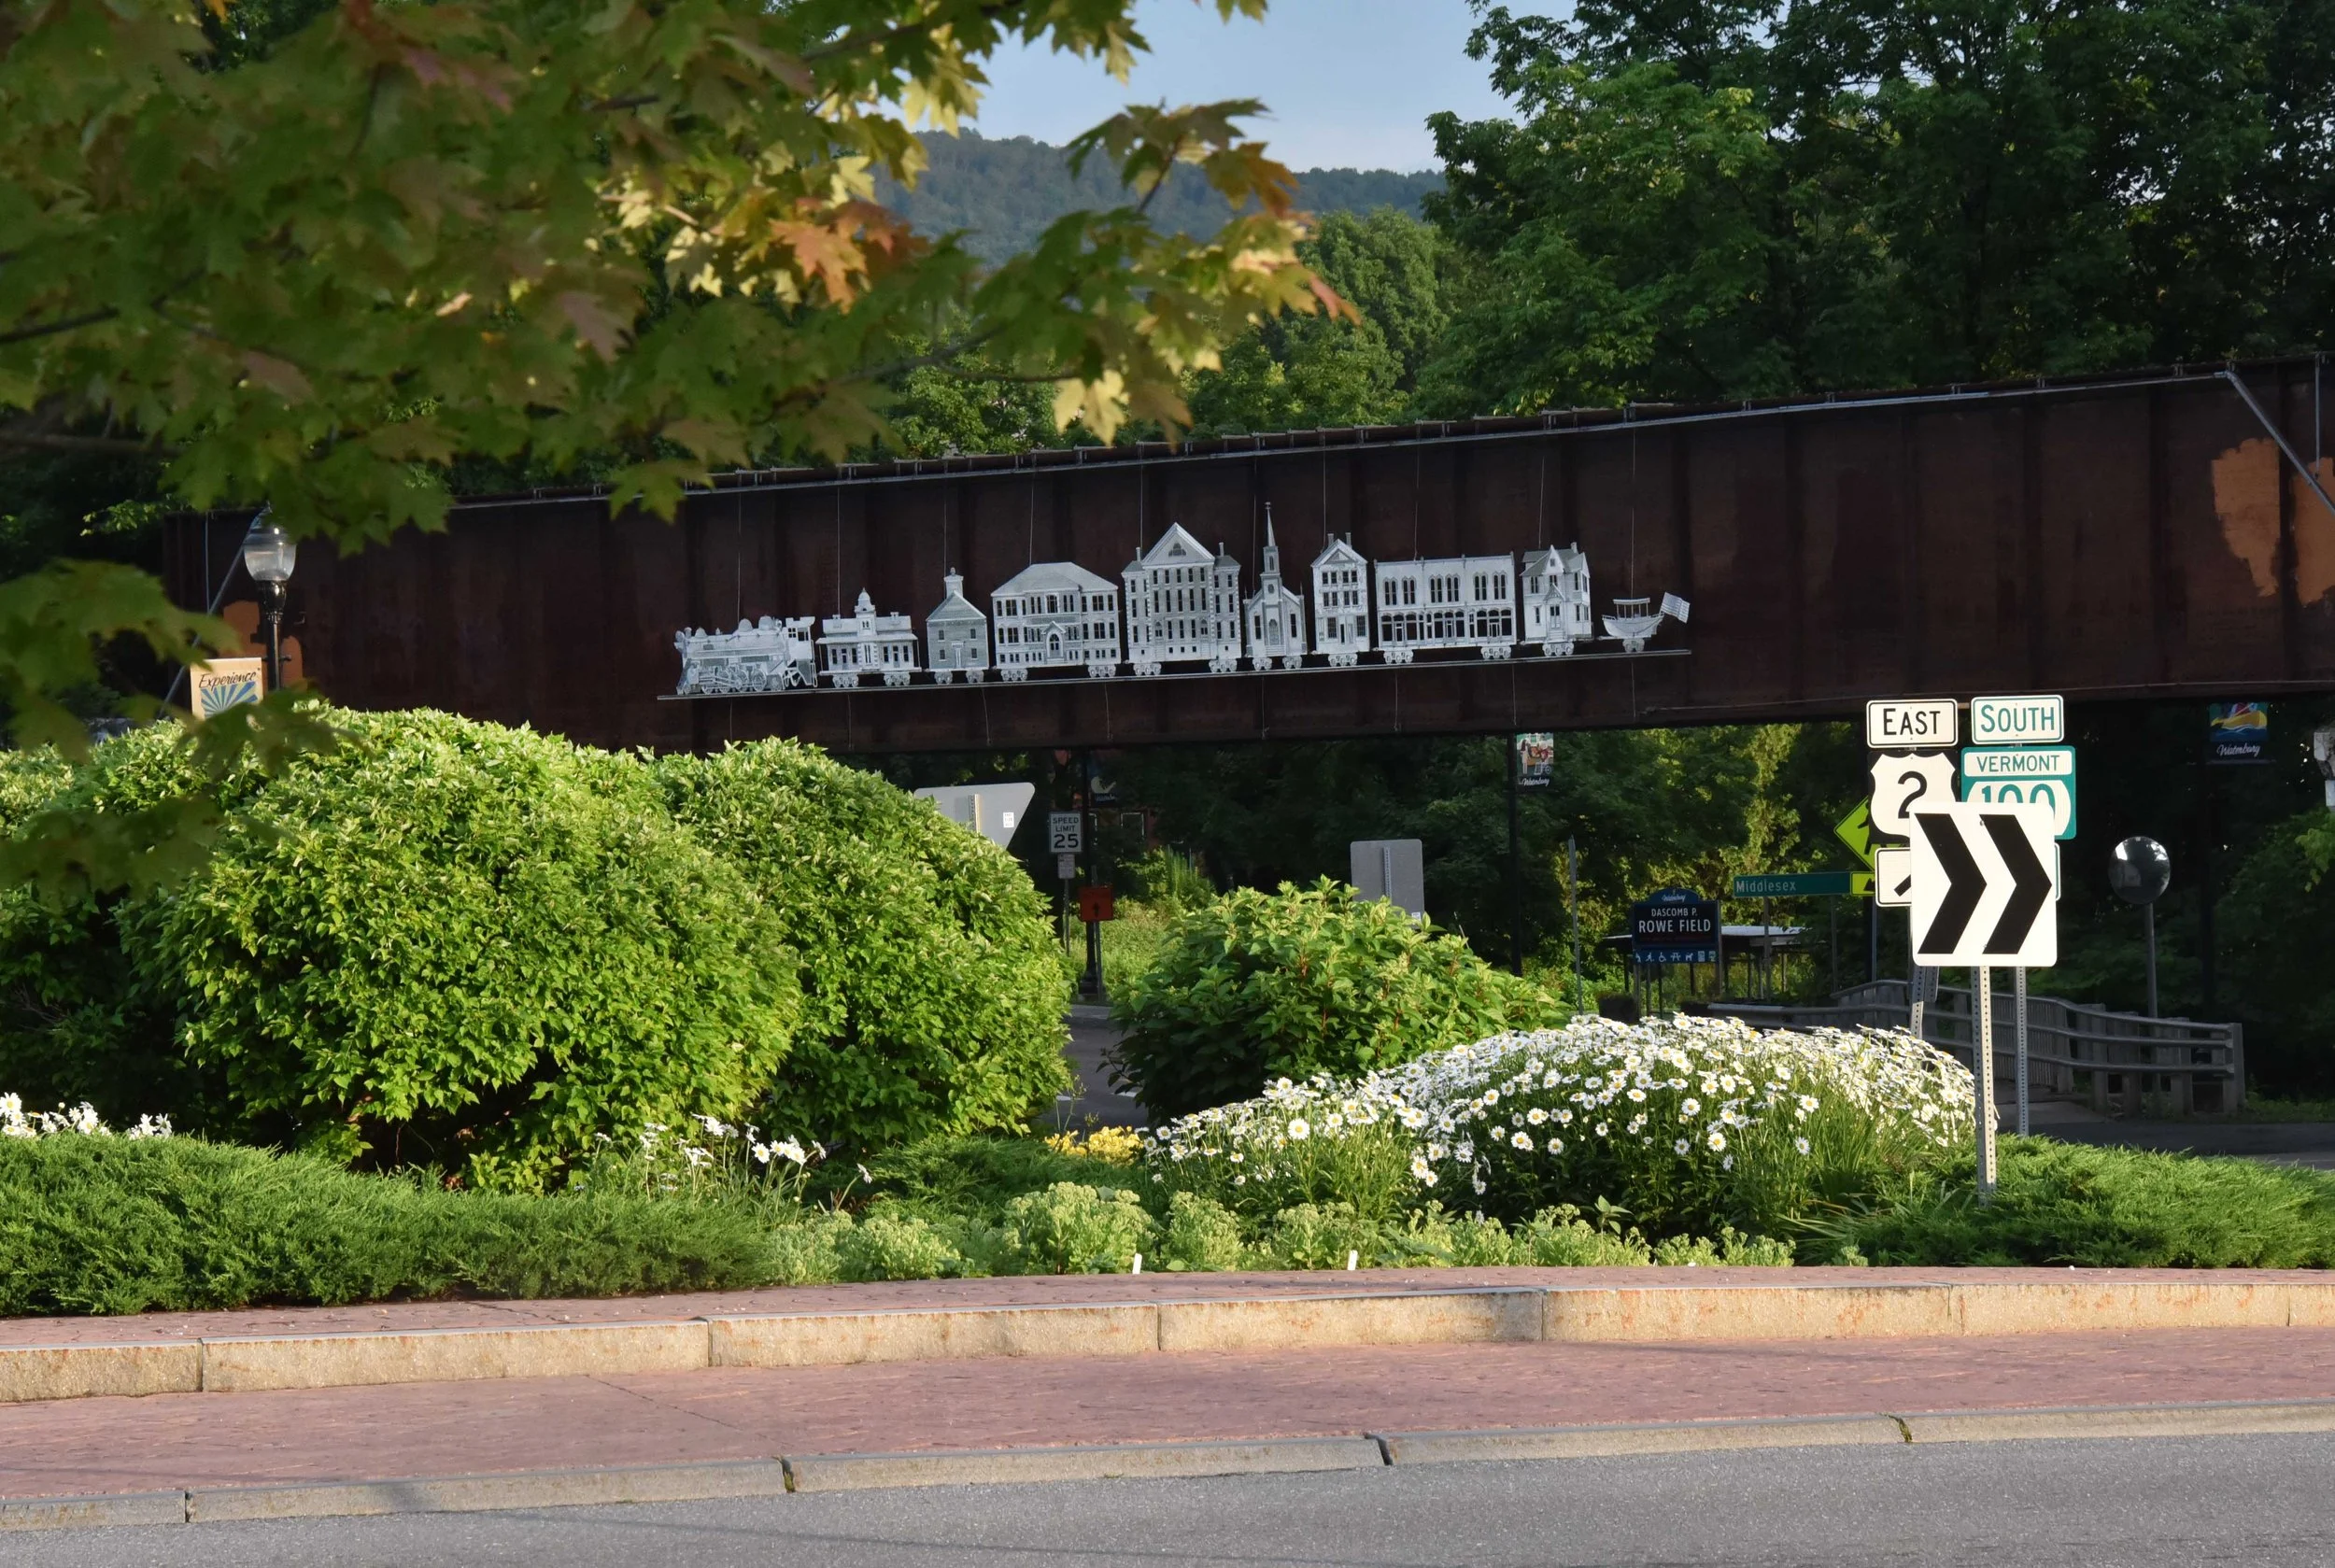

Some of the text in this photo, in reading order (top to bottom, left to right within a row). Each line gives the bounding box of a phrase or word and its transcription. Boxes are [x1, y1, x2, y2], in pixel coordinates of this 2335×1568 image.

[199, 671, 256, 692] Experience
[1883, 708, 1941, 735] EAST
[1980, 704, 2055, 732] SOUTH
[1976, 755, 2060, 772] VERMONT
[1897, 770, 1928, 819] 2
[1054, 833, 1079, 848] 25
[1736, 880, 1797, 893] Middlesex
[1651, 908, 1689, 917] DASCOMB
[1638, 919, 1711, 933] ROWE FIELD
